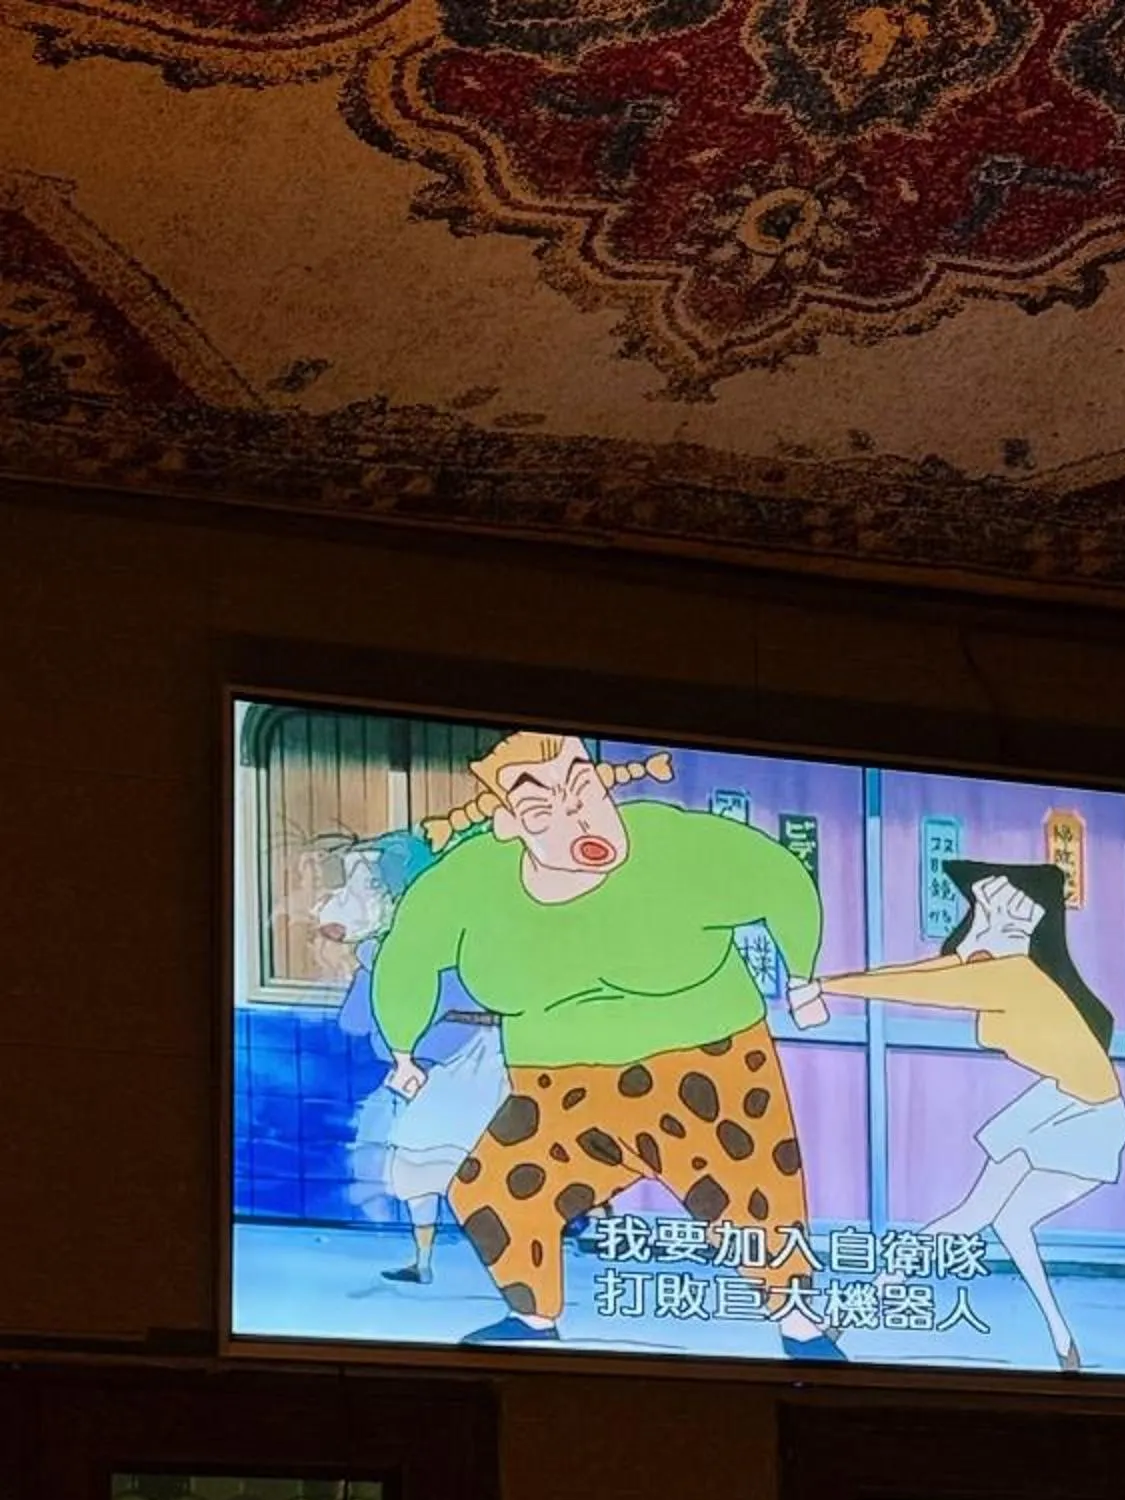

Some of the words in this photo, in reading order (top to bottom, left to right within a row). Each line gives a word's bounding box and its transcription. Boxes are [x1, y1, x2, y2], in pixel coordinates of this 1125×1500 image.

[594, 1213, 989, 1279] 我要加入自衛隊
[594, 1267, 991, 1333] 打敗巨大機器人
